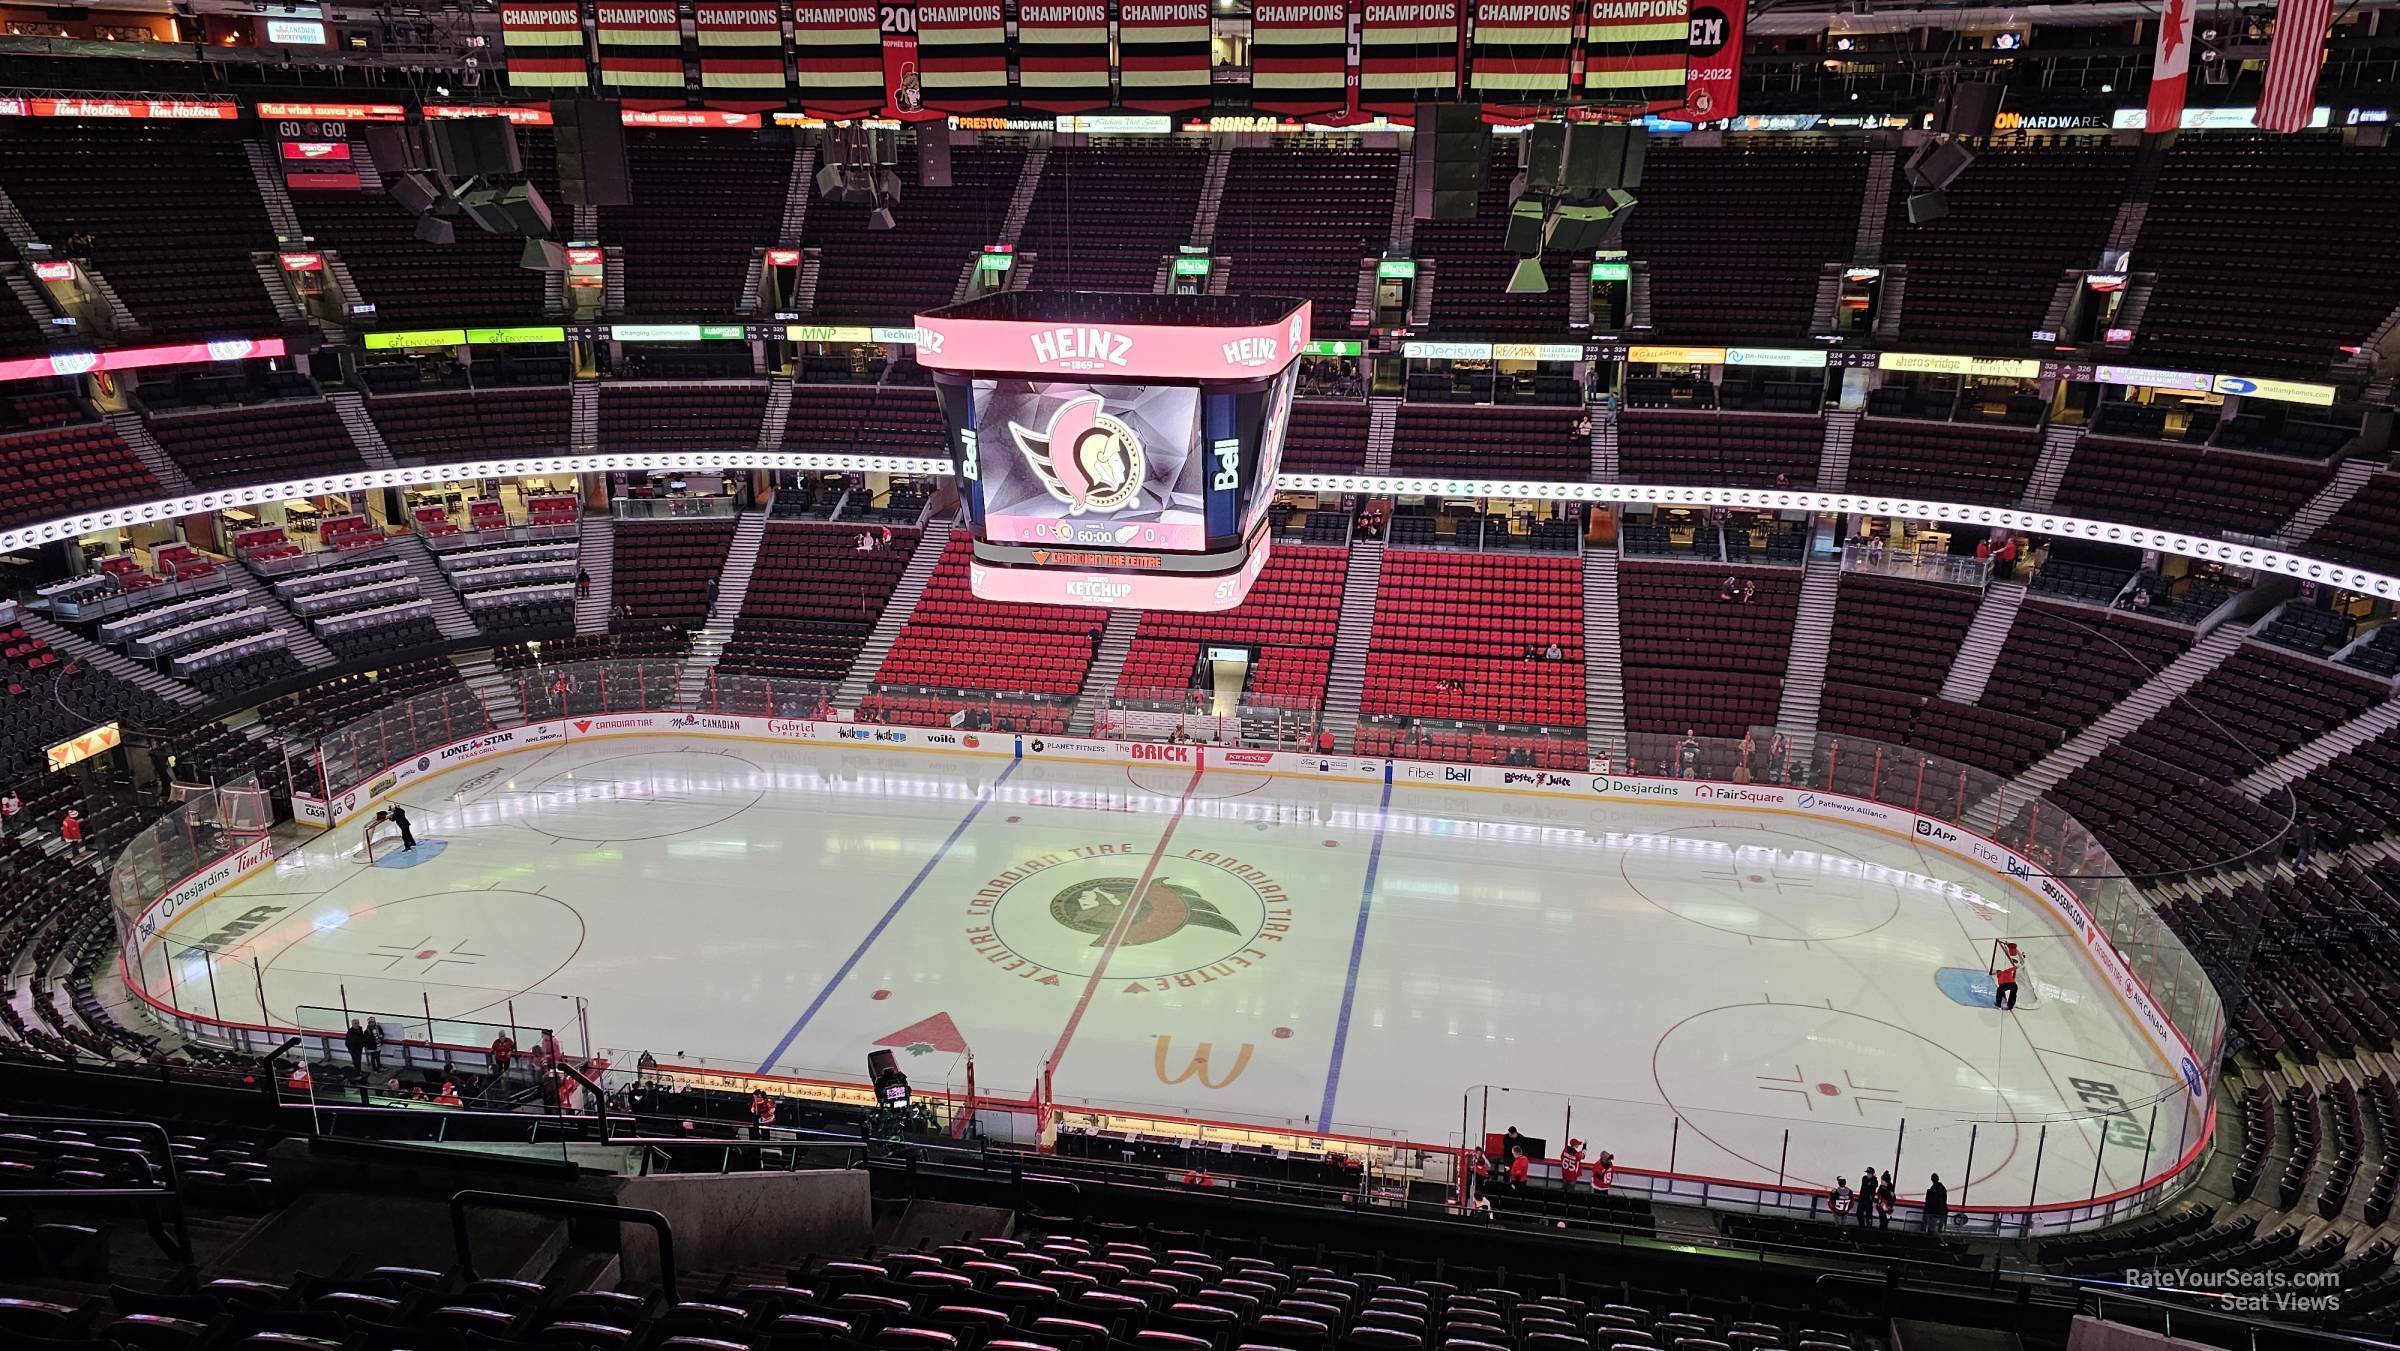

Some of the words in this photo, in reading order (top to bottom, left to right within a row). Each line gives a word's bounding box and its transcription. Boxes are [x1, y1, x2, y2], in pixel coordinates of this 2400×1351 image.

[503, 9, 578, 25] CHAMPIONS
[598, 8, 676, 24] CHAMPIONS
[697, 9, 777, 25] CHAMPIONS
[796, 7, 876, 23] CHAMPIONS
[919, 5, 1000, 22] CHAMPIONS
[1021, 6, 1104, 22] CHAMPIONS
[1122, 5, 1207, 21] CHAMPIONS
[1256, 5, 1343, 22] CHAMPIONS
[1366, 3, 1455, 21] CHAMPIONS
[1479, 4, 1571, 21] CHAMPIONS
[1592, 0, 1687, 19] CHAMPIONS
[1690, 18, 1722, 45] EM
[56, 102, 78, 116] Tim
[80, 103, 129, 116] Hortons
[150, 103, 172, 116] Tim
[173, 104, 220, 117] Hortons
[262, 104, 285, 115] Find
[287, 106, 312, 115] what
[315, 107, 345, 116] moves
[635, 113, 656, 122] what
[688, 115, 704, 124] you
[960, 117, 1007, 130] PRESTON
[1006, 120, 1055, 130] HARDWARE
[1210, 116, 1278, 132] SIGNS.CA
[2018, 116, 2101, 128] HARDWARE
[280, 122, 300, 138] GO
[322, 122, 346, 138] GO!
[802, 328, 837, 340] MNP
[1030, 328, 1134, 366] HEINZ
[1222, 338, 1278, 364] HEINZ
[1424, 343, 1486, 358] Decisive
[1496, 344, 1536, 356] RE/MAX
[1861, 360, 1875, 368] 225
[961, 428, 978, 480] Bell
[1214, 438, 1239, 491] Bell
[1036, 524, 1046, 537] 0
[1078, 530, 1112, 544] 60:00
[1144, 528, 1155, 542] 0
[1052, 552, 1102, 564] CANADIAN
[1104, 554, 1125, 566] TIRE
[1127, 556, 1162, 568] CENTRE
[1066, 582, 1132, 598] KETCHUP
[1214, 580, 1238, 598] 57
[596, 720, 636, 730] CANADIAN
[637, 719, 653, 728] TIRE
[702, 718, 740, 730] CANADIAN
[768, 719, 815, 734] Gabriel
[441, 743, 470, 760] LONE
[484, 732, 514, 746] STAR
[928, 734, 956, 744] voilà
[458, 752, 478, 761] TEXAS
[478, 746, 498, 755] GRILL
[1046, 742, 1075, 750] PLANET
[1076, 744, 1106, 753] FITNESS
[1116, 744, 1130, 752] The
[1132, 744, 1188, 762] BRICK
[1408, 766, 1434, 779] Fibe
[1446, 766, 1471, 782] Bell
[1504, 772, 1536, 784] Booster
[1546, 774, 1572, 786] Juice
[1614, 781, 1678, 797] Desjardins
[1717, 788, 1784, 804] FairSquare
[1818, 800, 1855, 813] Pathways
[1856, 806, 1888, 820] Alliance
[1067, 843, 1134, 858] TIRE
[1973, 842, 1998, 864] Fibe
[2008, 856, 2030, 882] Bell
[1186, 848, 1288, 904] CANADIAN
[967, 854, 1063, 916] CANADIAN
[139, 914, 156, 942] Bell
[176, 867, 230, 906] Desjardins
[235, 854, 258, 874] Tim
[1258, 908, 1292, 942] TIRE
[966, 924, 1043, 979] CENTRE
[1156, 948, 1267, 992] CENTRE
[2134, 992, 2144, 1010] AIR
[2143, 1004, 2168, 1042] CANADA
[1562, 1158, 1576, 1172] 65
[1835, 1200, 1851, 1211] 57
